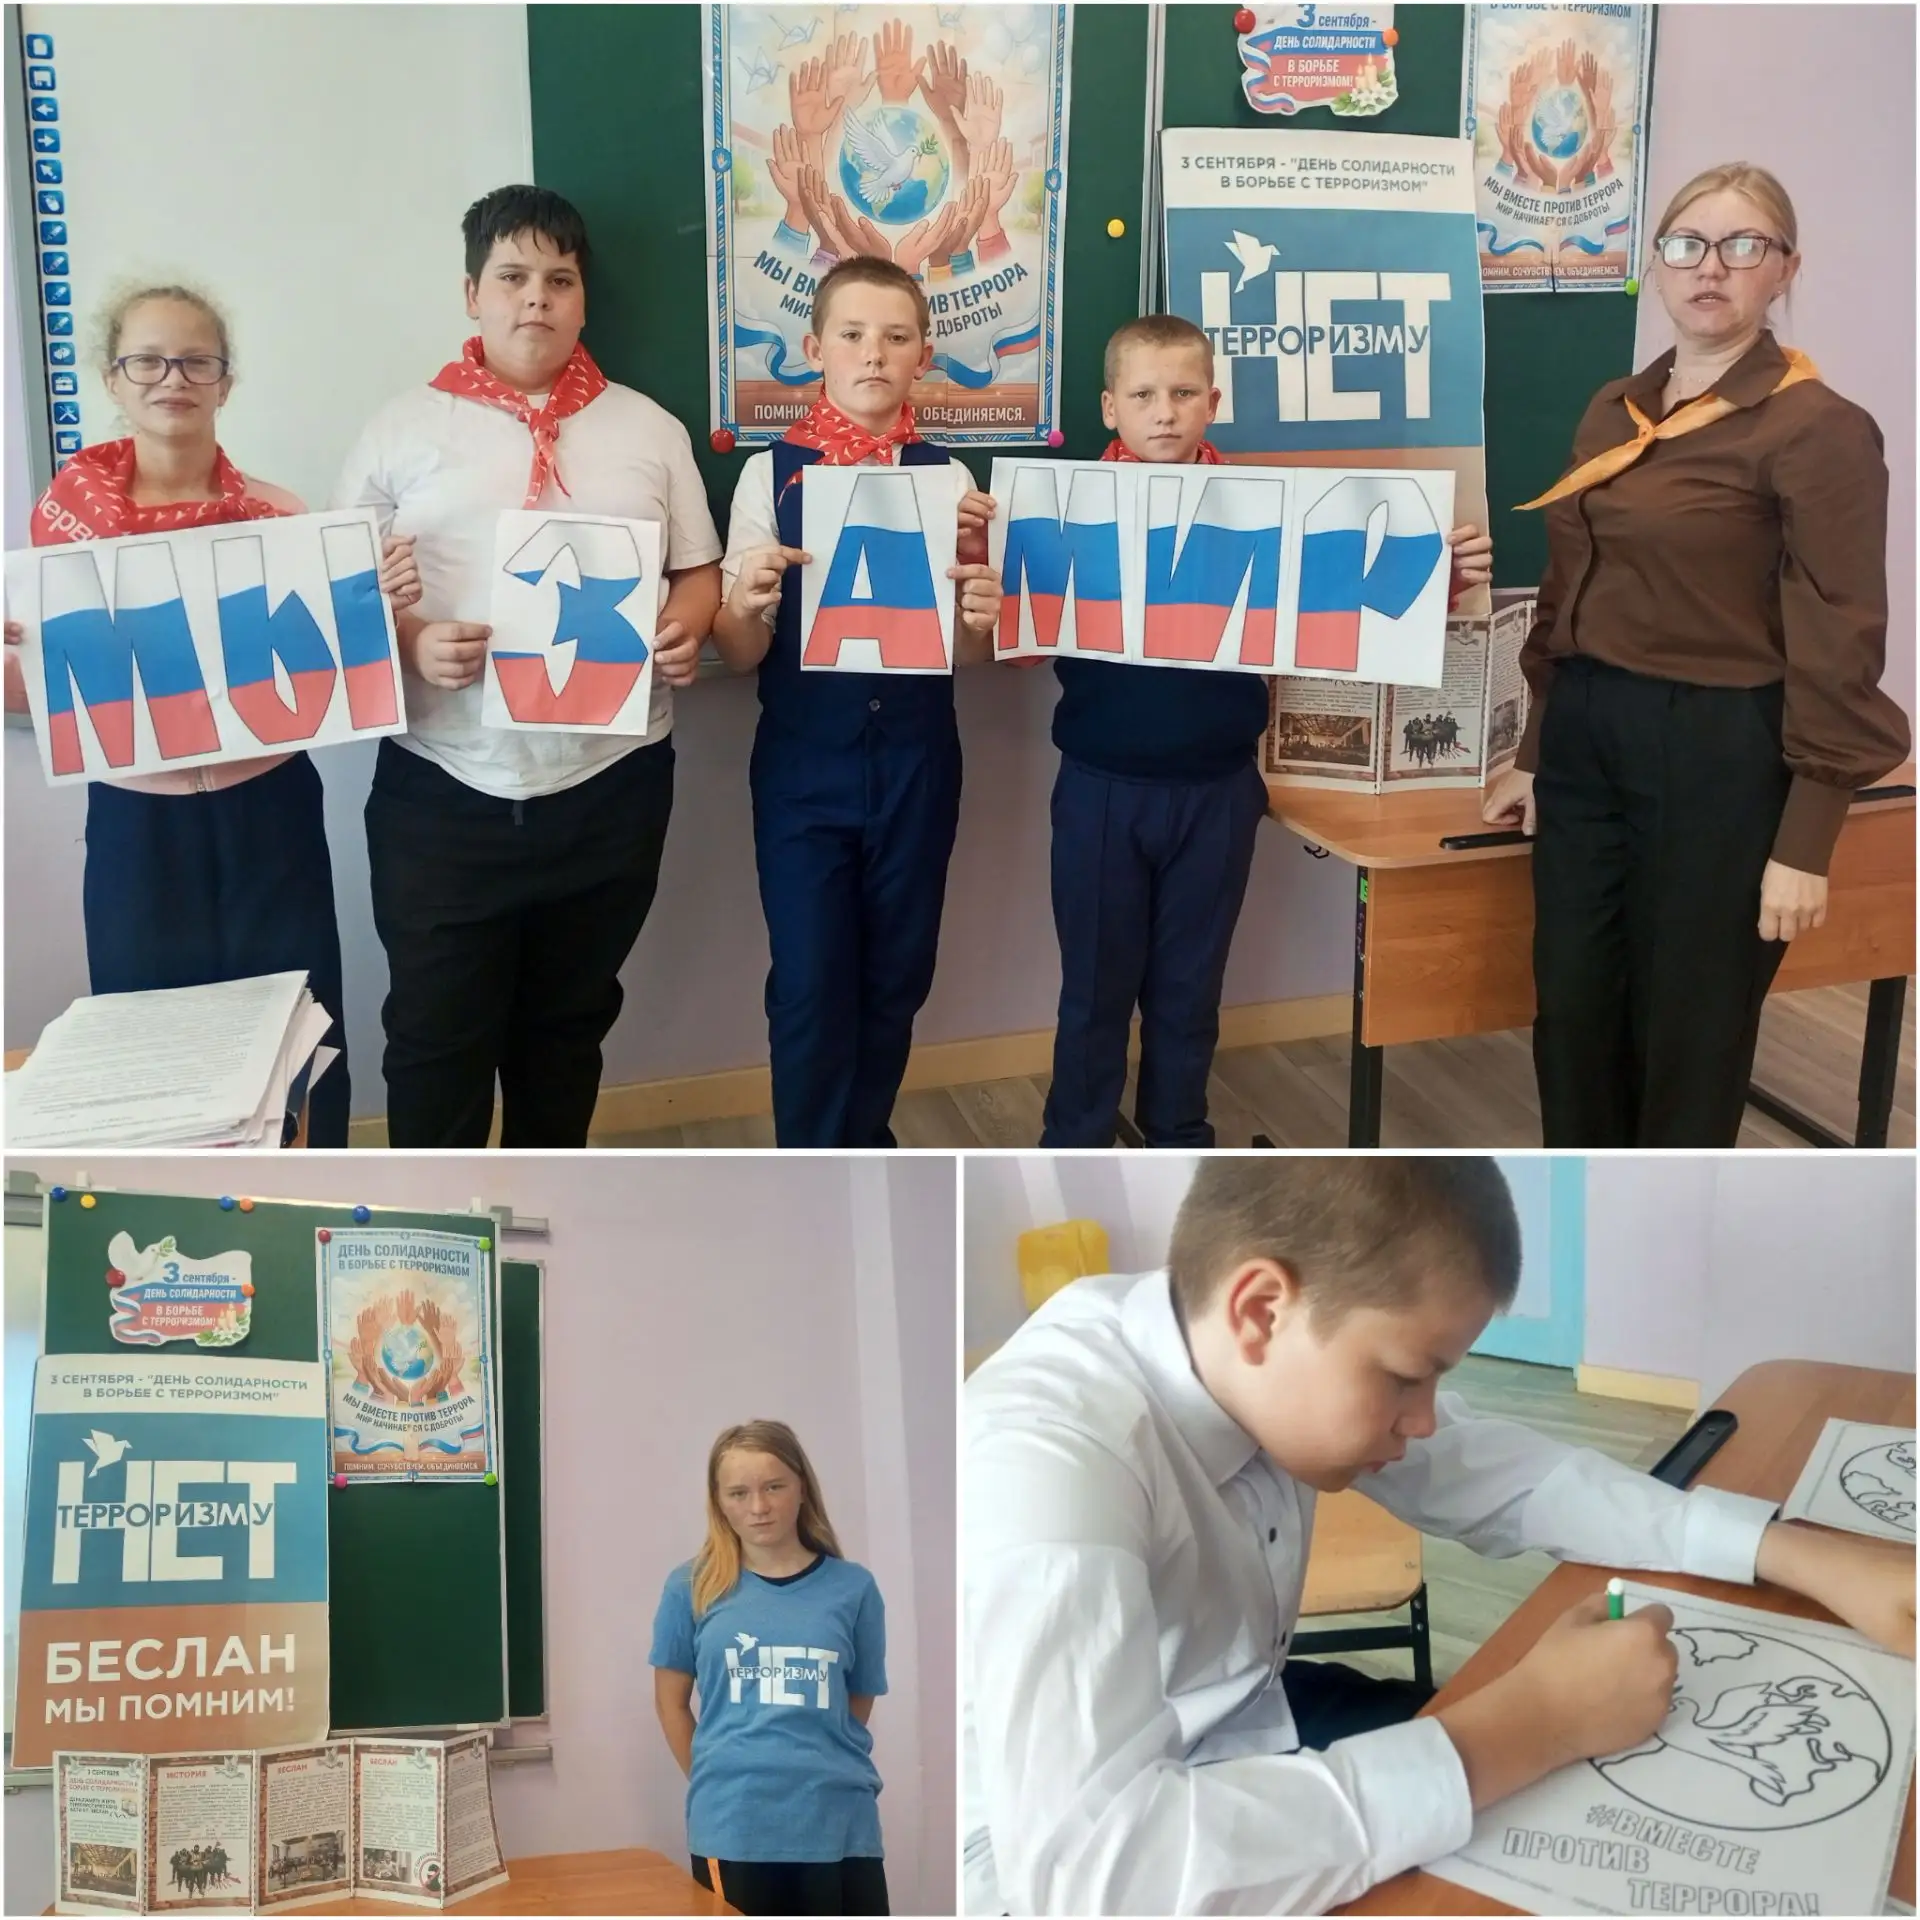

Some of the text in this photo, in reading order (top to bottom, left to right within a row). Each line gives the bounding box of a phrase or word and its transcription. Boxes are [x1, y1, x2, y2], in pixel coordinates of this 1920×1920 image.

[1296, 4, 1316, 27] 3
[1318, 14, 1369, 29] сентября
[1274, 36, 1376, 49] ДЕНЬ СОЛИДАРНОСТИ
[1288, 59, 1340, 73] В БОРЬБЕ
[1274, 75, 1353, 87] С ТЕРРОРИЗМОМ!
[1181, 158, 1190, 169] 3
[1195, 157, 1275, 169] СЕНТЯБРЯ
[1290, 158, 1337, 172] "ДЕНЬ
[1341, 160, 1455, 176] СОЛИДАРНОСТИ
[1221, 176, 1428, 192] В БОРЬБЕ С ТЕРРОРИЗМОМ"
[1484, 176, 1624, 214] МЫ ВМЕСТЕ ПРОТИВ ТЕРРОРА
[1496, 202, 1513, 215] МИР
[1573, 203, 1610, 226] ДОБРОТЫ
[753, 250, 792, 285] МЫ
[1482, 267, 1511, 277] ОМНИМ.
[949, 262, 1028, 311] ТЕРРОРА
[1200, 271, 1451, 424] НЕТ
[1204, 324, 1429, 356] ТЕРРОРИЗМУ
[923, 407, 1026, 424] ОБЪЕДИНЯЕМСЯ.
[38, 486, 100, 541] ерв
[41, 521, 399, 776] МЫ
[997, 466, 1443, 672] МИР
[338, 1244, 470, 1264] ДЕНЬ СОЛИДАРНОСТИ
[162, 1262, 180, 1283] 3
[182, 1273, 229, 1284] сентября
[339, 1260, 470, 1277] В БОРЬБЕ С ТЕРРОРИЗМОМ
[144, 1288, 236, 1299] ДЕНЬ СОЛИДАРНОСТИ
[142, 1317, 216, 1327] С ТЕРРОРИЗМОМ!
[156, 1305, 204, 1315] В БОРЬБЕ
[51, 1375, 58, 1385] 3
[62, 1374, 134, 1385] СЕНТЯБРЯ
[147, 1374, 190, 1386] "ДЕНЬ
[195, 1375, 308, 1390] СОЛИДАРНОСТИ
[83, 1388, 279, 1401] В БОРЬБЕ С ТЕРРОРИЗМОМ"
[343, 1393, 475, 1422] МЫ ВМЕСТЕ ПРОТИВ ТЕРРОРА
[355, 1413, 372, 1425] МИР
[430, 1414, 463, 1432] ДОБРОТЫ
[52, 1460, 297, 1584] НЕТ
[57, 1502, 273, 1528] ТЕРРОРИЗМУ
[46, 1633, 295, 1684] БЕСЛАН
[725, 1646, 839, 1709] НЕТ
[728, 1666, 828, 1682] ТЕРРОРИЗМУ
[45, 1687, 295, 1724] МЫ ПОМНИМ!
[1502, 1827, 1650, 1874] ПРОТИВ
[1585, 1804, 1761, 1875] #ВМЕСТЕ
[1627, 1878, 1820, 1916] ТЕРРОРА!
